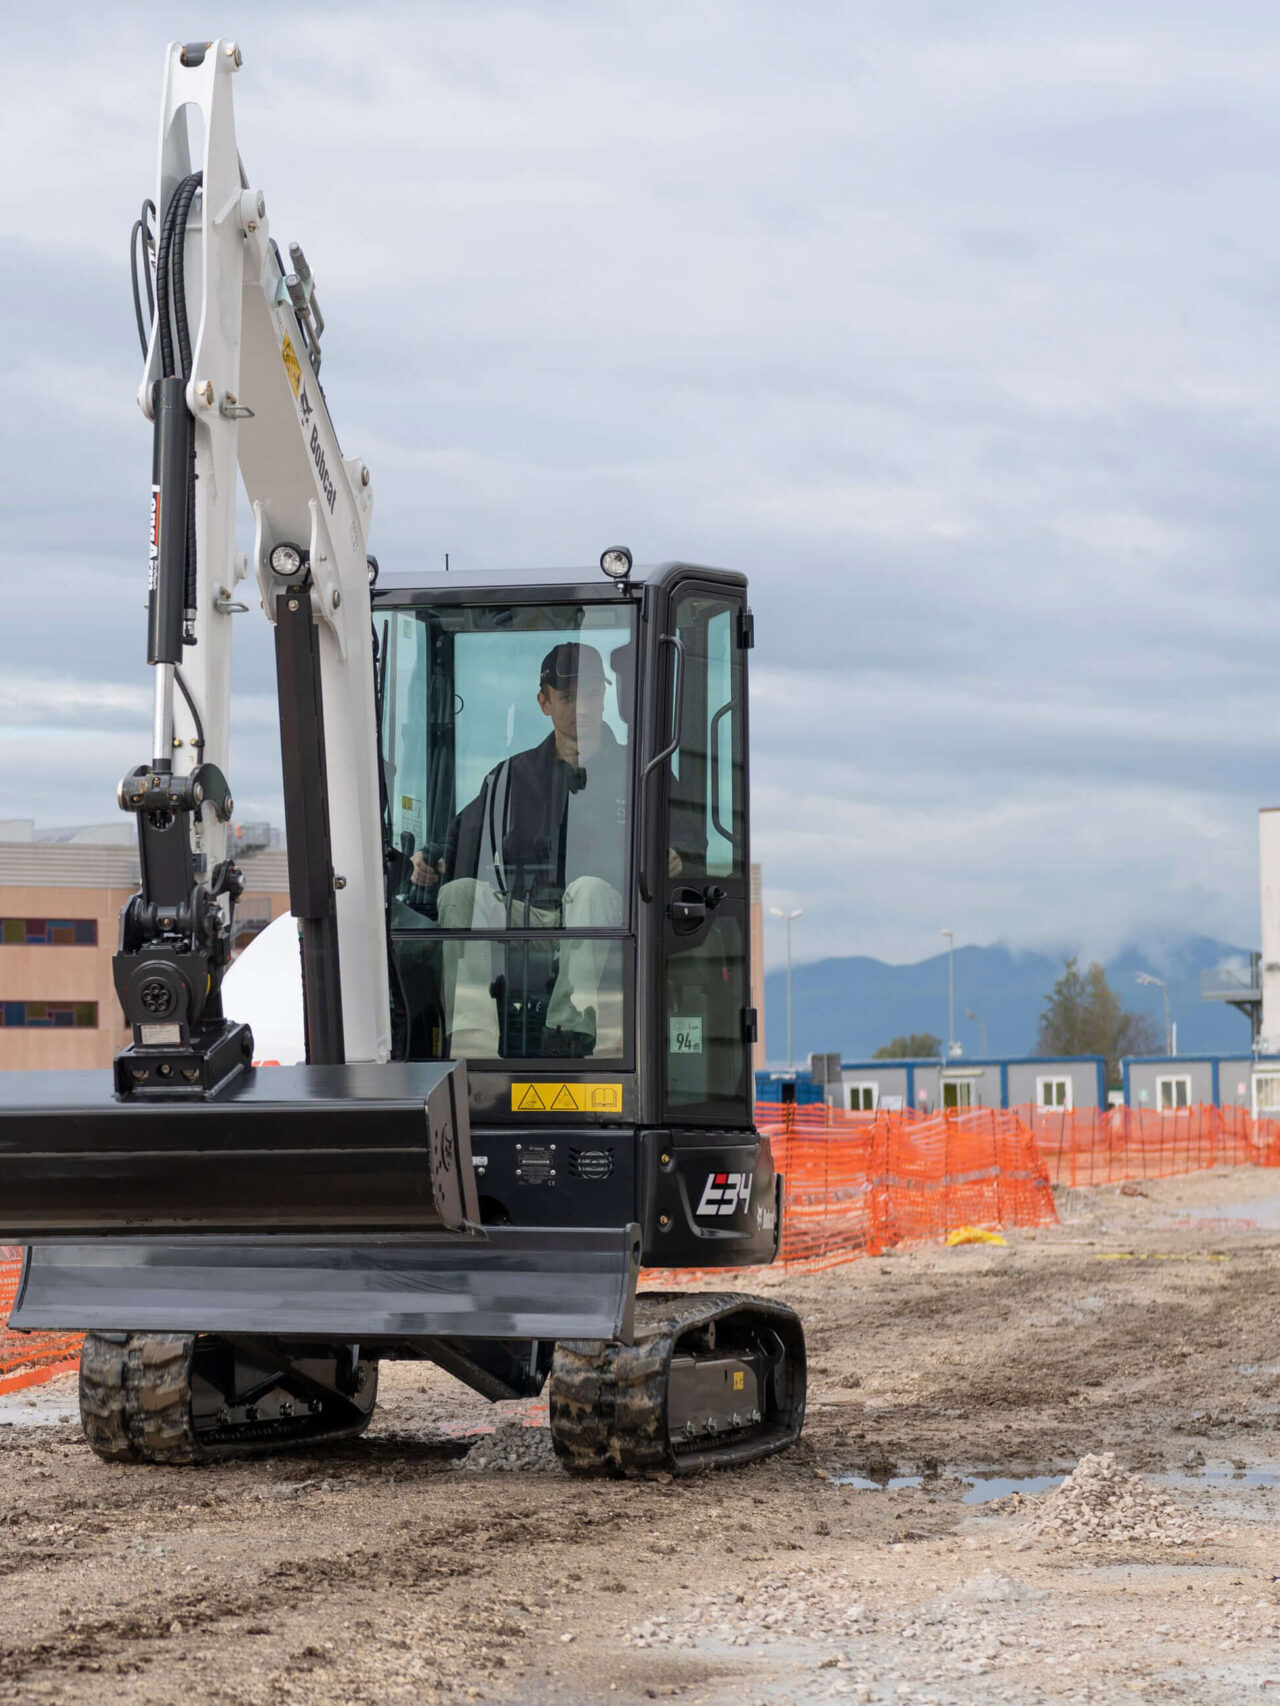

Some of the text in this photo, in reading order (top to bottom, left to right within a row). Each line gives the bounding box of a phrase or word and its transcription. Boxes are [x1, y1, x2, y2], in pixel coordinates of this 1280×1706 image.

[310, 423, 337, 515] Bobcat
[676, 1032, 691, 1050] 94
[696, 1173, 753, 1215] E34
